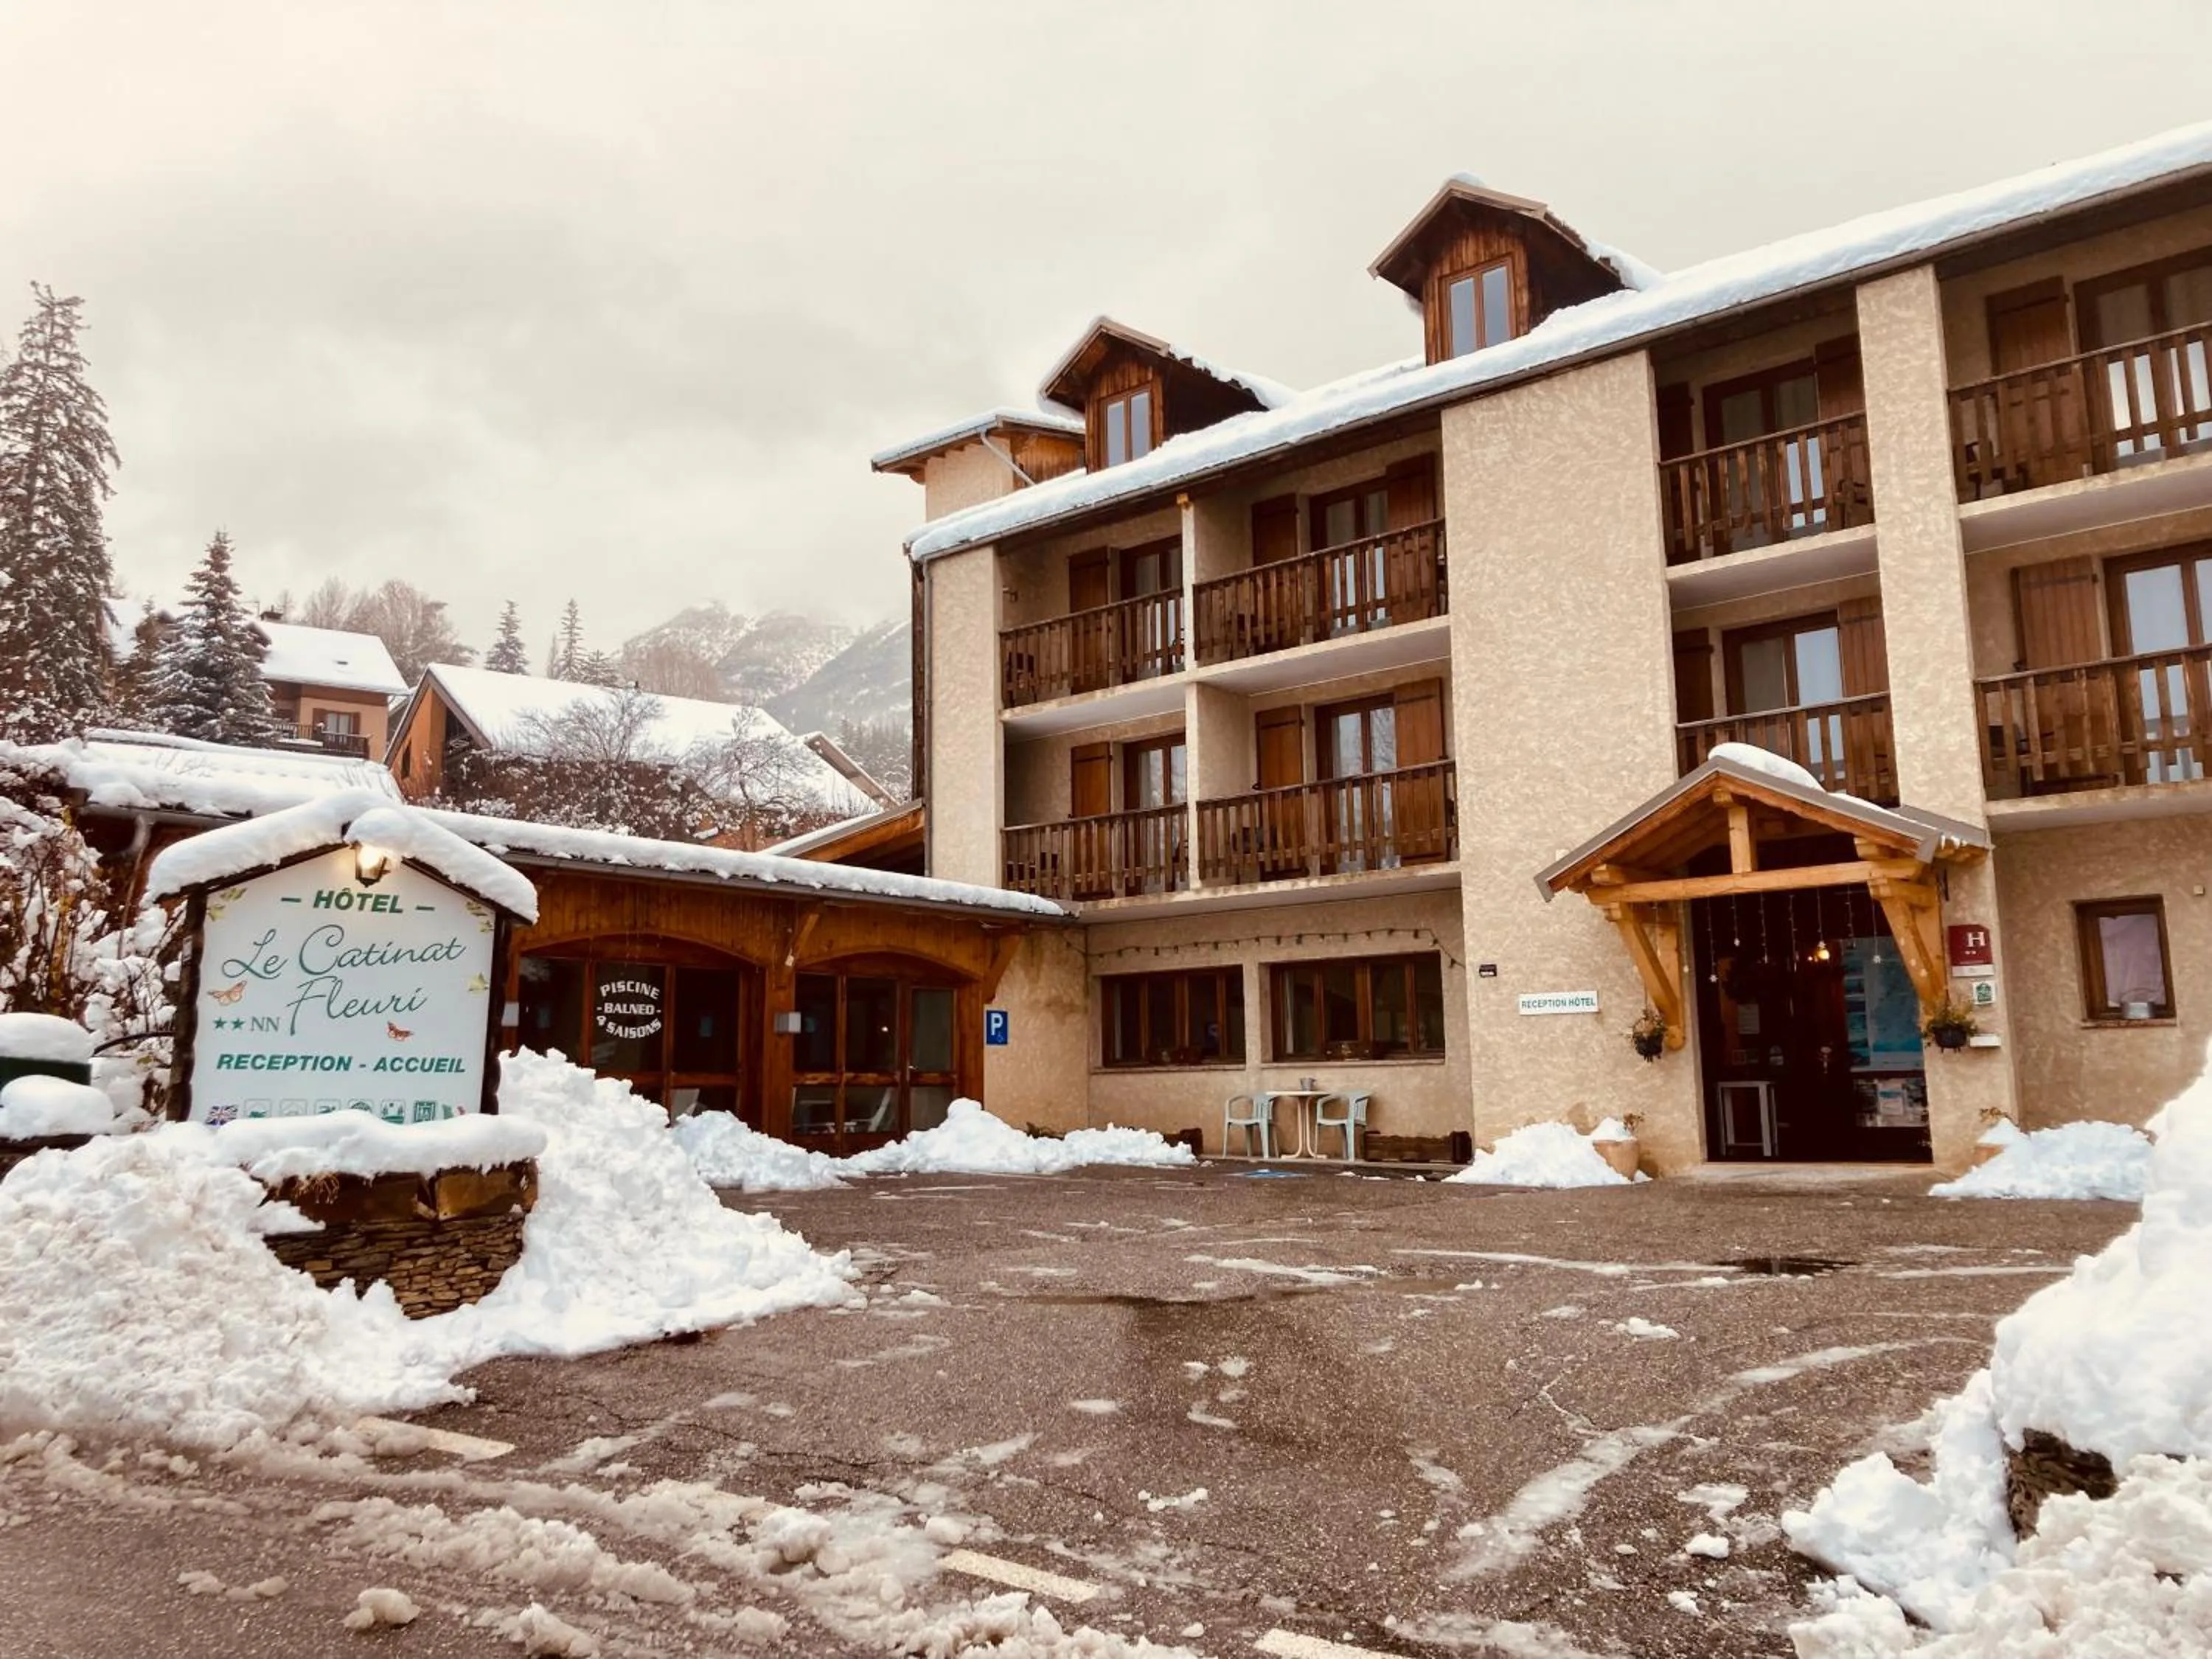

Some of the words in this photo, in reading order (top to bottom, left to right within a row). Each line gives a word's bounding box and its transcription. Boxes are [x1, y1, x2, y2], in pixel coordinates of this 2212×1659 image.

[313, 888, 404, 914] HÔTEL
[1966, 931, 1986, 947] H
[221, 928, 288, 980] Le
[299, 924, 467, 975] Catinat
[599, 980, 661, 1000] PISCINE
[285, 975, 428, 1036] Fleuri
[1521, 999, 1567, 1009] RECEPTION
[250, 1017, 280, 1032] NN
[605, 1018, 662, 1039] SAISONS
[990, 1012, 1004, 1036] P
[216, 1054, 352, 1072] RECEPTION
[372, 1057, 466, 1074] ACCUEIL
